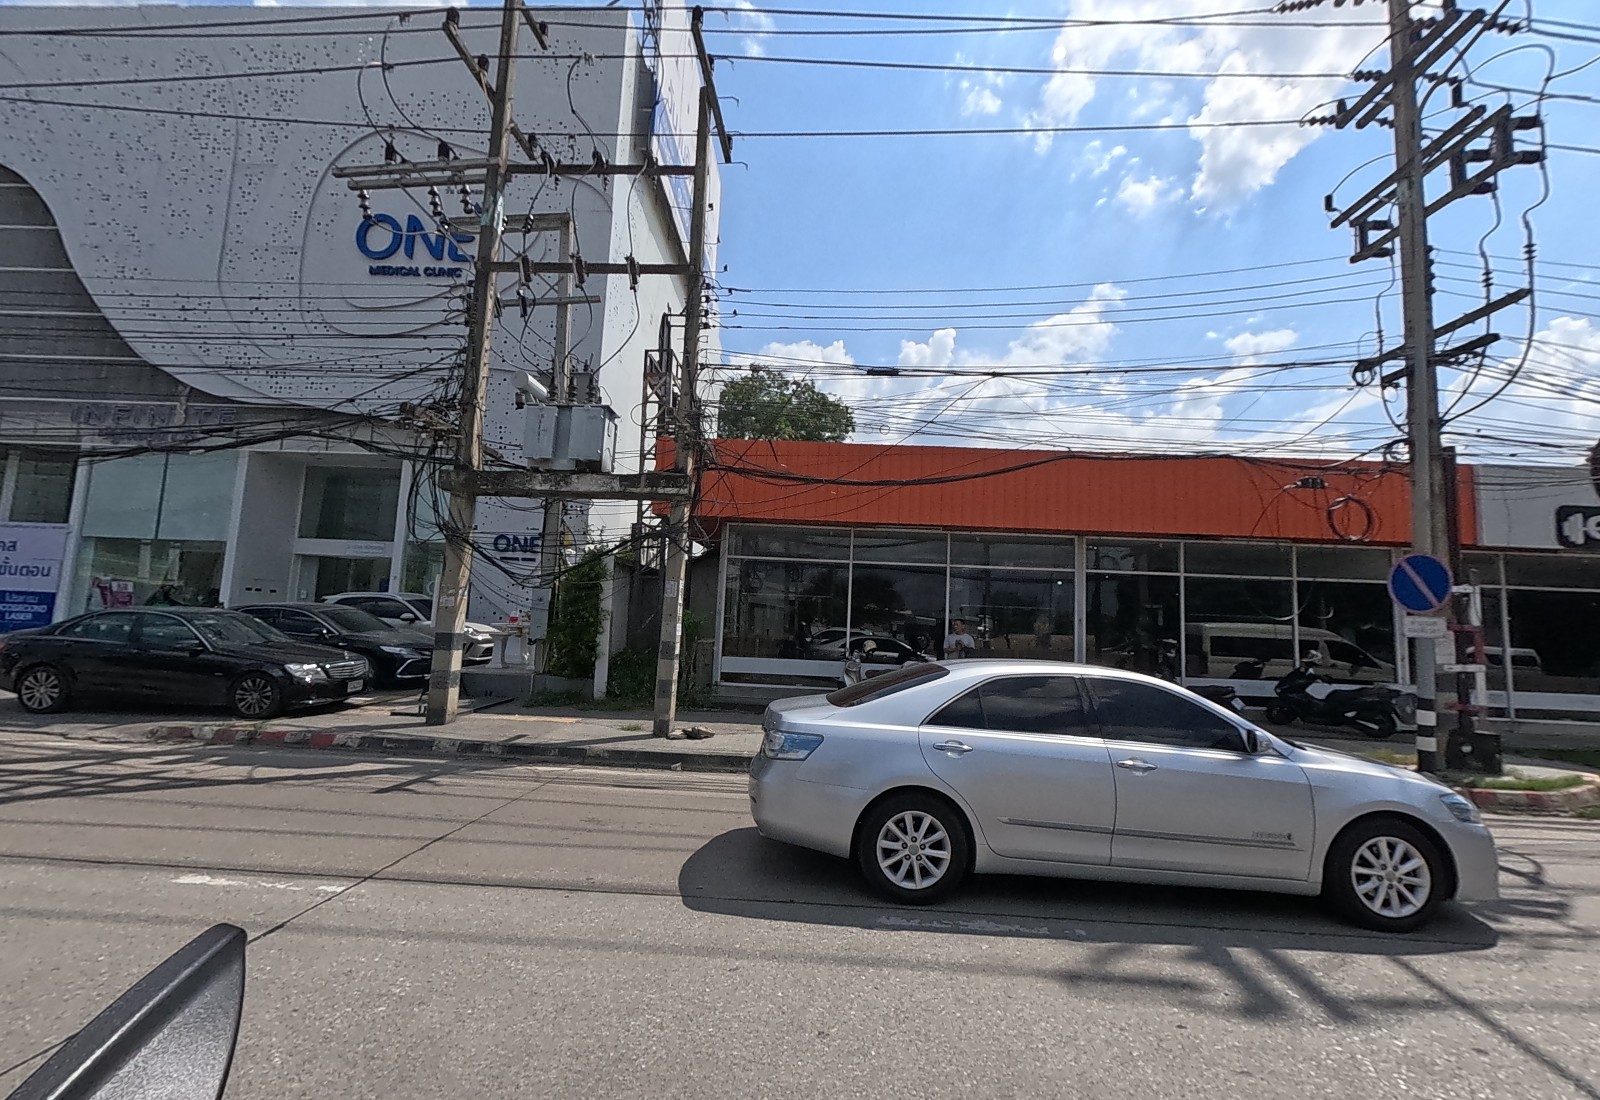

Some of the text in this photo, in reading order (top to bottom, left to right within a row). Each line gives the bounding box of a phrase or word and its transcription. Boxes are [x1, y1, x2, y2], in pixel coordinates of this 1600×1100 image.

[356, 213, 475, 263] ONE
[368, 265, 463, 278] MEDICAL CLINIC
[493, 533, 541, 553] ONE
[4, 612, 33, 621] LASER
